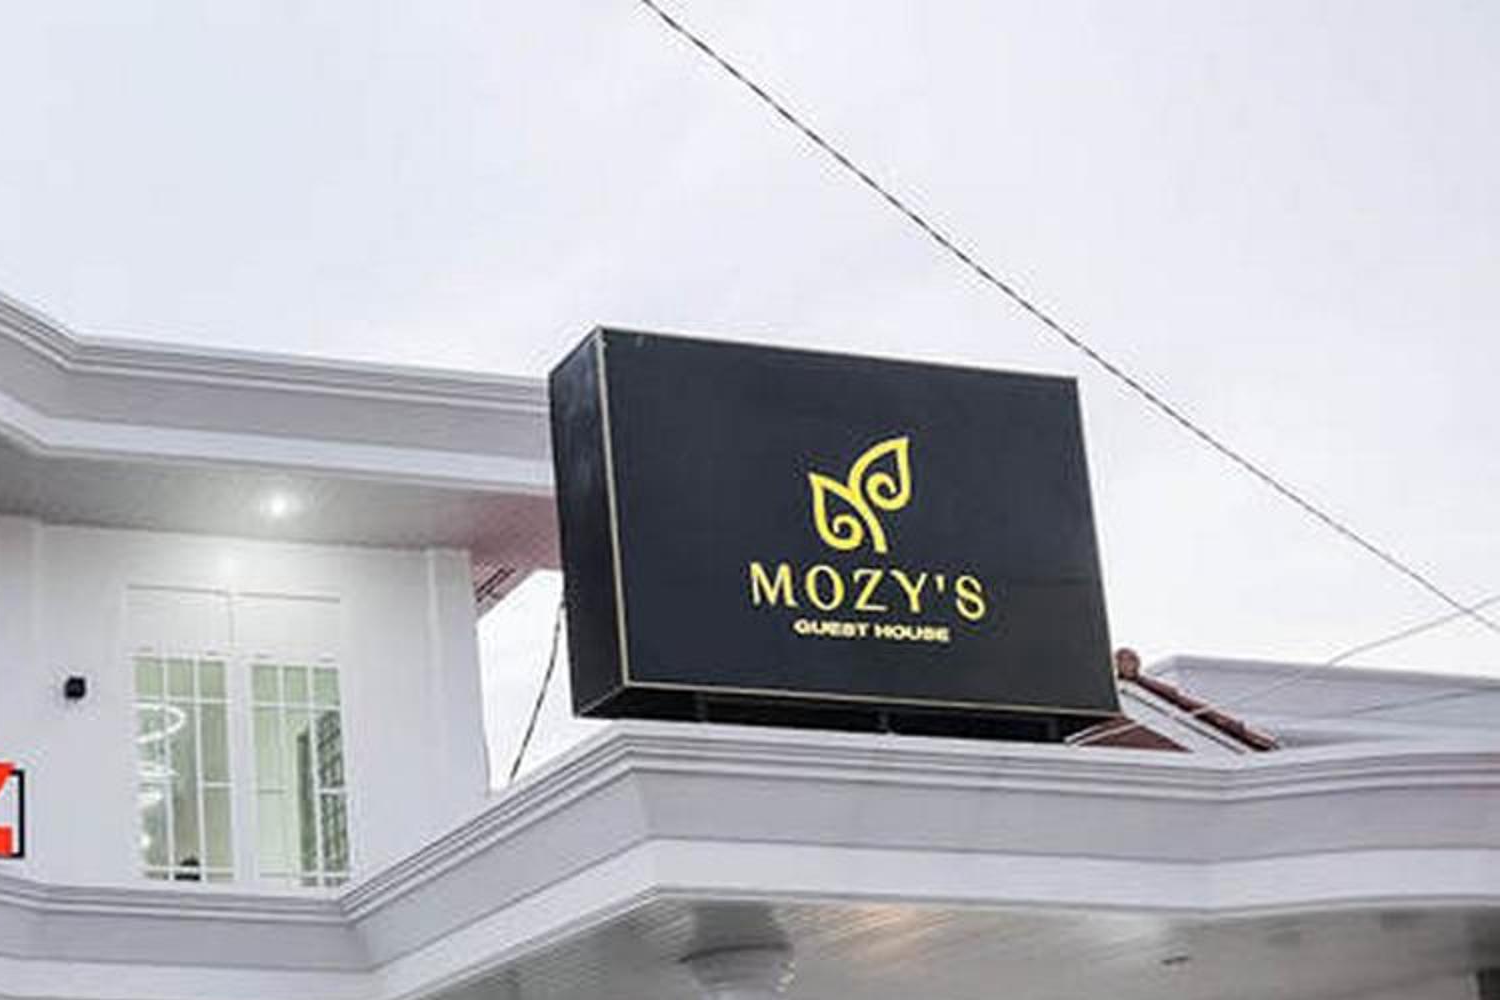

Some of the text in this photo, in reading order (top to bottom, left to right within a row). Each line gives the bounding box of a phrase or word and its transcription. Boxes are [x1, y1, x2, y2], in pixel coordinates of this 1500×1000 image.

[749, 561, 986, 621] MOZY'S
[793, 618, 950, 643] GUEST HOUSE
